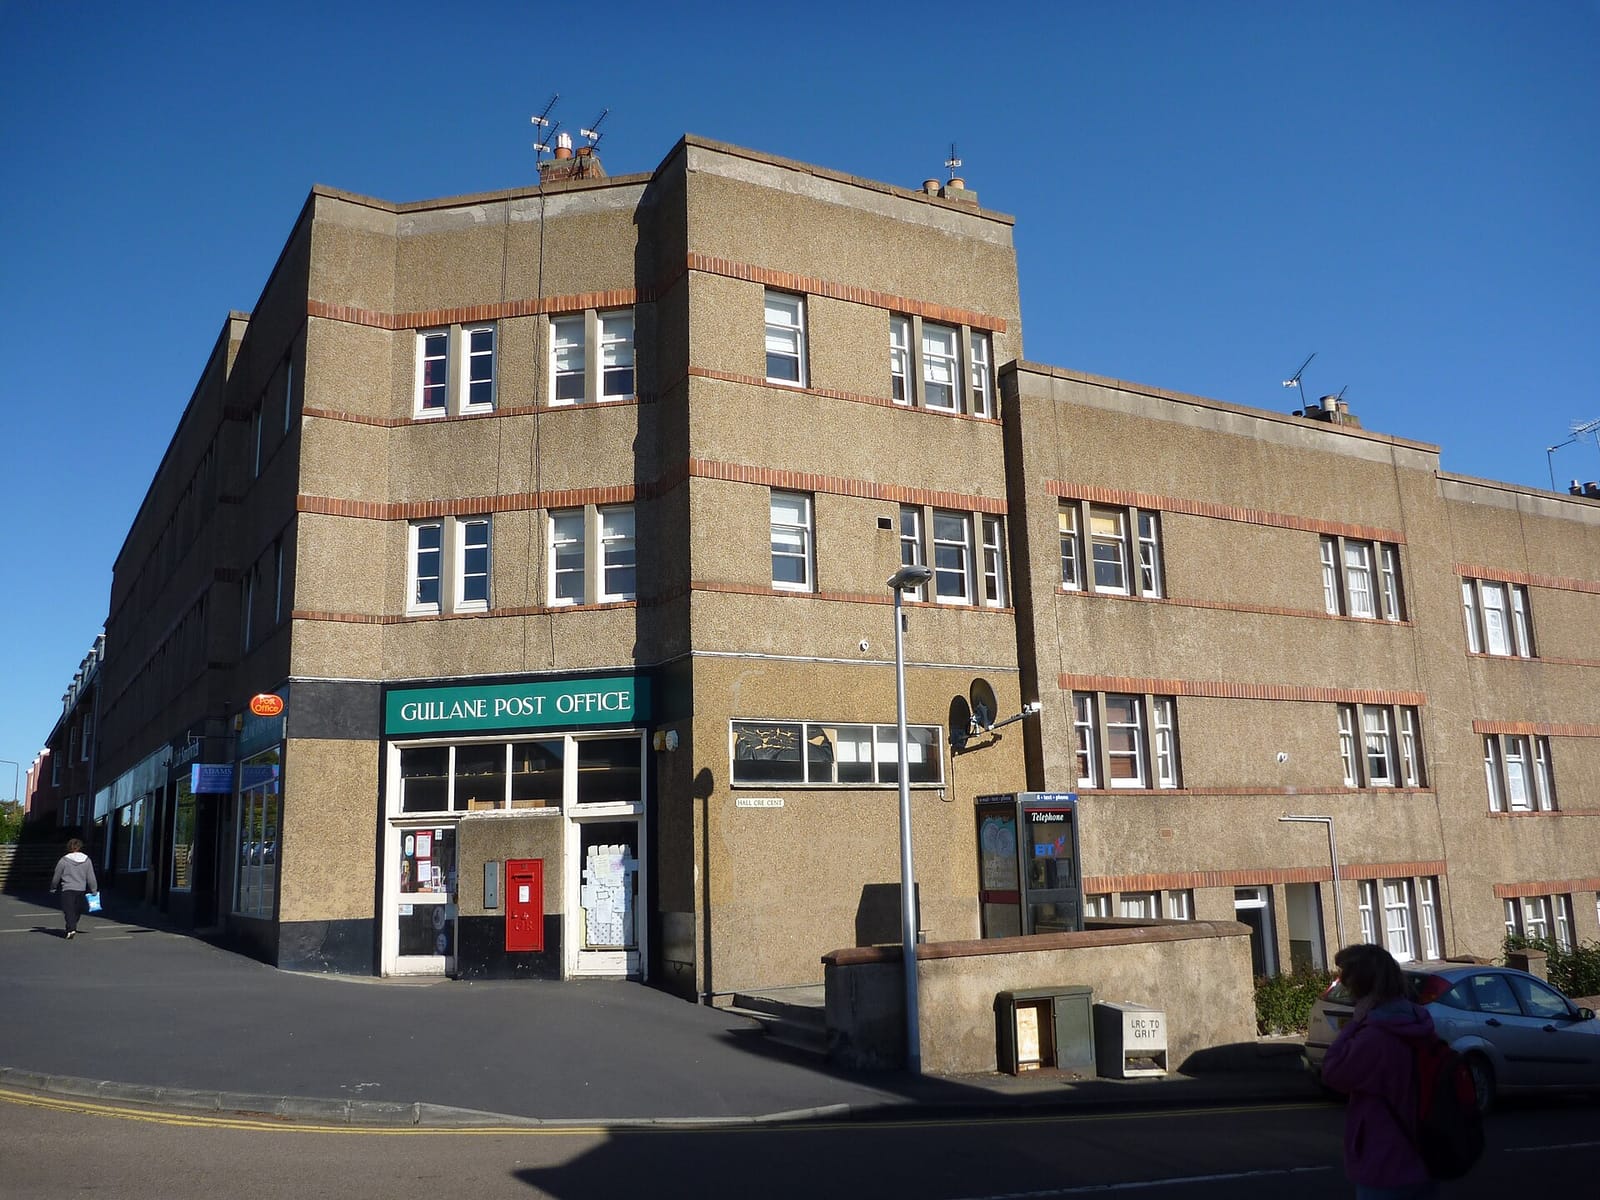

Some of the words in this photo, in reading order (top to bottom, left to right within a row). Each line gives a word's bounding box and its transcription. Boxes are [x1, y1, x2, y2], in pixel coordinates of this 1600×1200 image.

[260, 697, 275, 705] Post
[401, 699, 488, 721] GULLANE
[495, 696, 546, 716] POST
[556, 691, 631, 713] OFFICE
[255, 704, 279, 712] Office
[1031, 812, 1064, 823] Telephone
[1035, 843, 1055, 857] BT
[1131, 1019, 1146, 1029] LRC
[1134, 1030, 1156, 1038] GRIT
